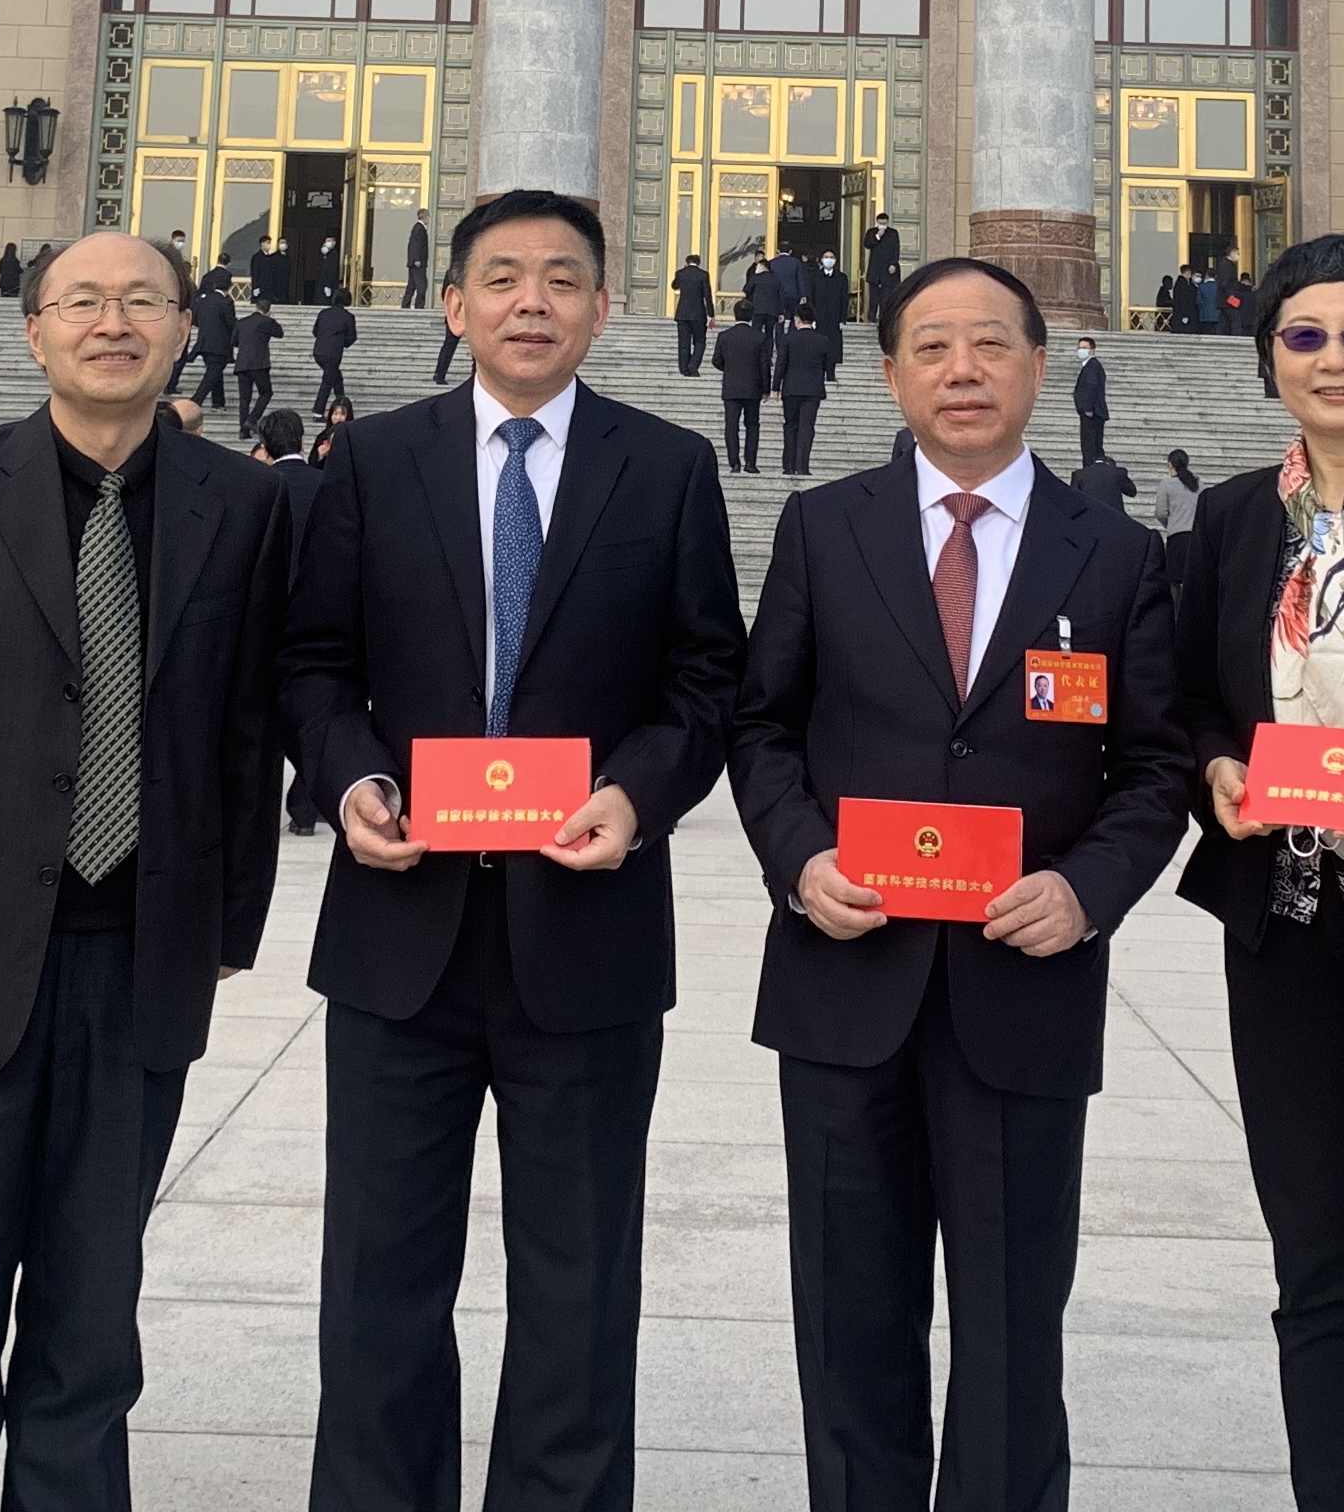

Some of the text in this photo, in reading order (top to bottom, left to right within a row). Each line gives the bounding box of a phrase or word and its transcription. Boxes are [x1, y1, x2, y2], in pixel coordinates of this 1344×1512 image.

[436, 809, 565, 823] 国家科学技术奖励大会
[863, 873, 994, 893] 国家科学技术奖励大会
